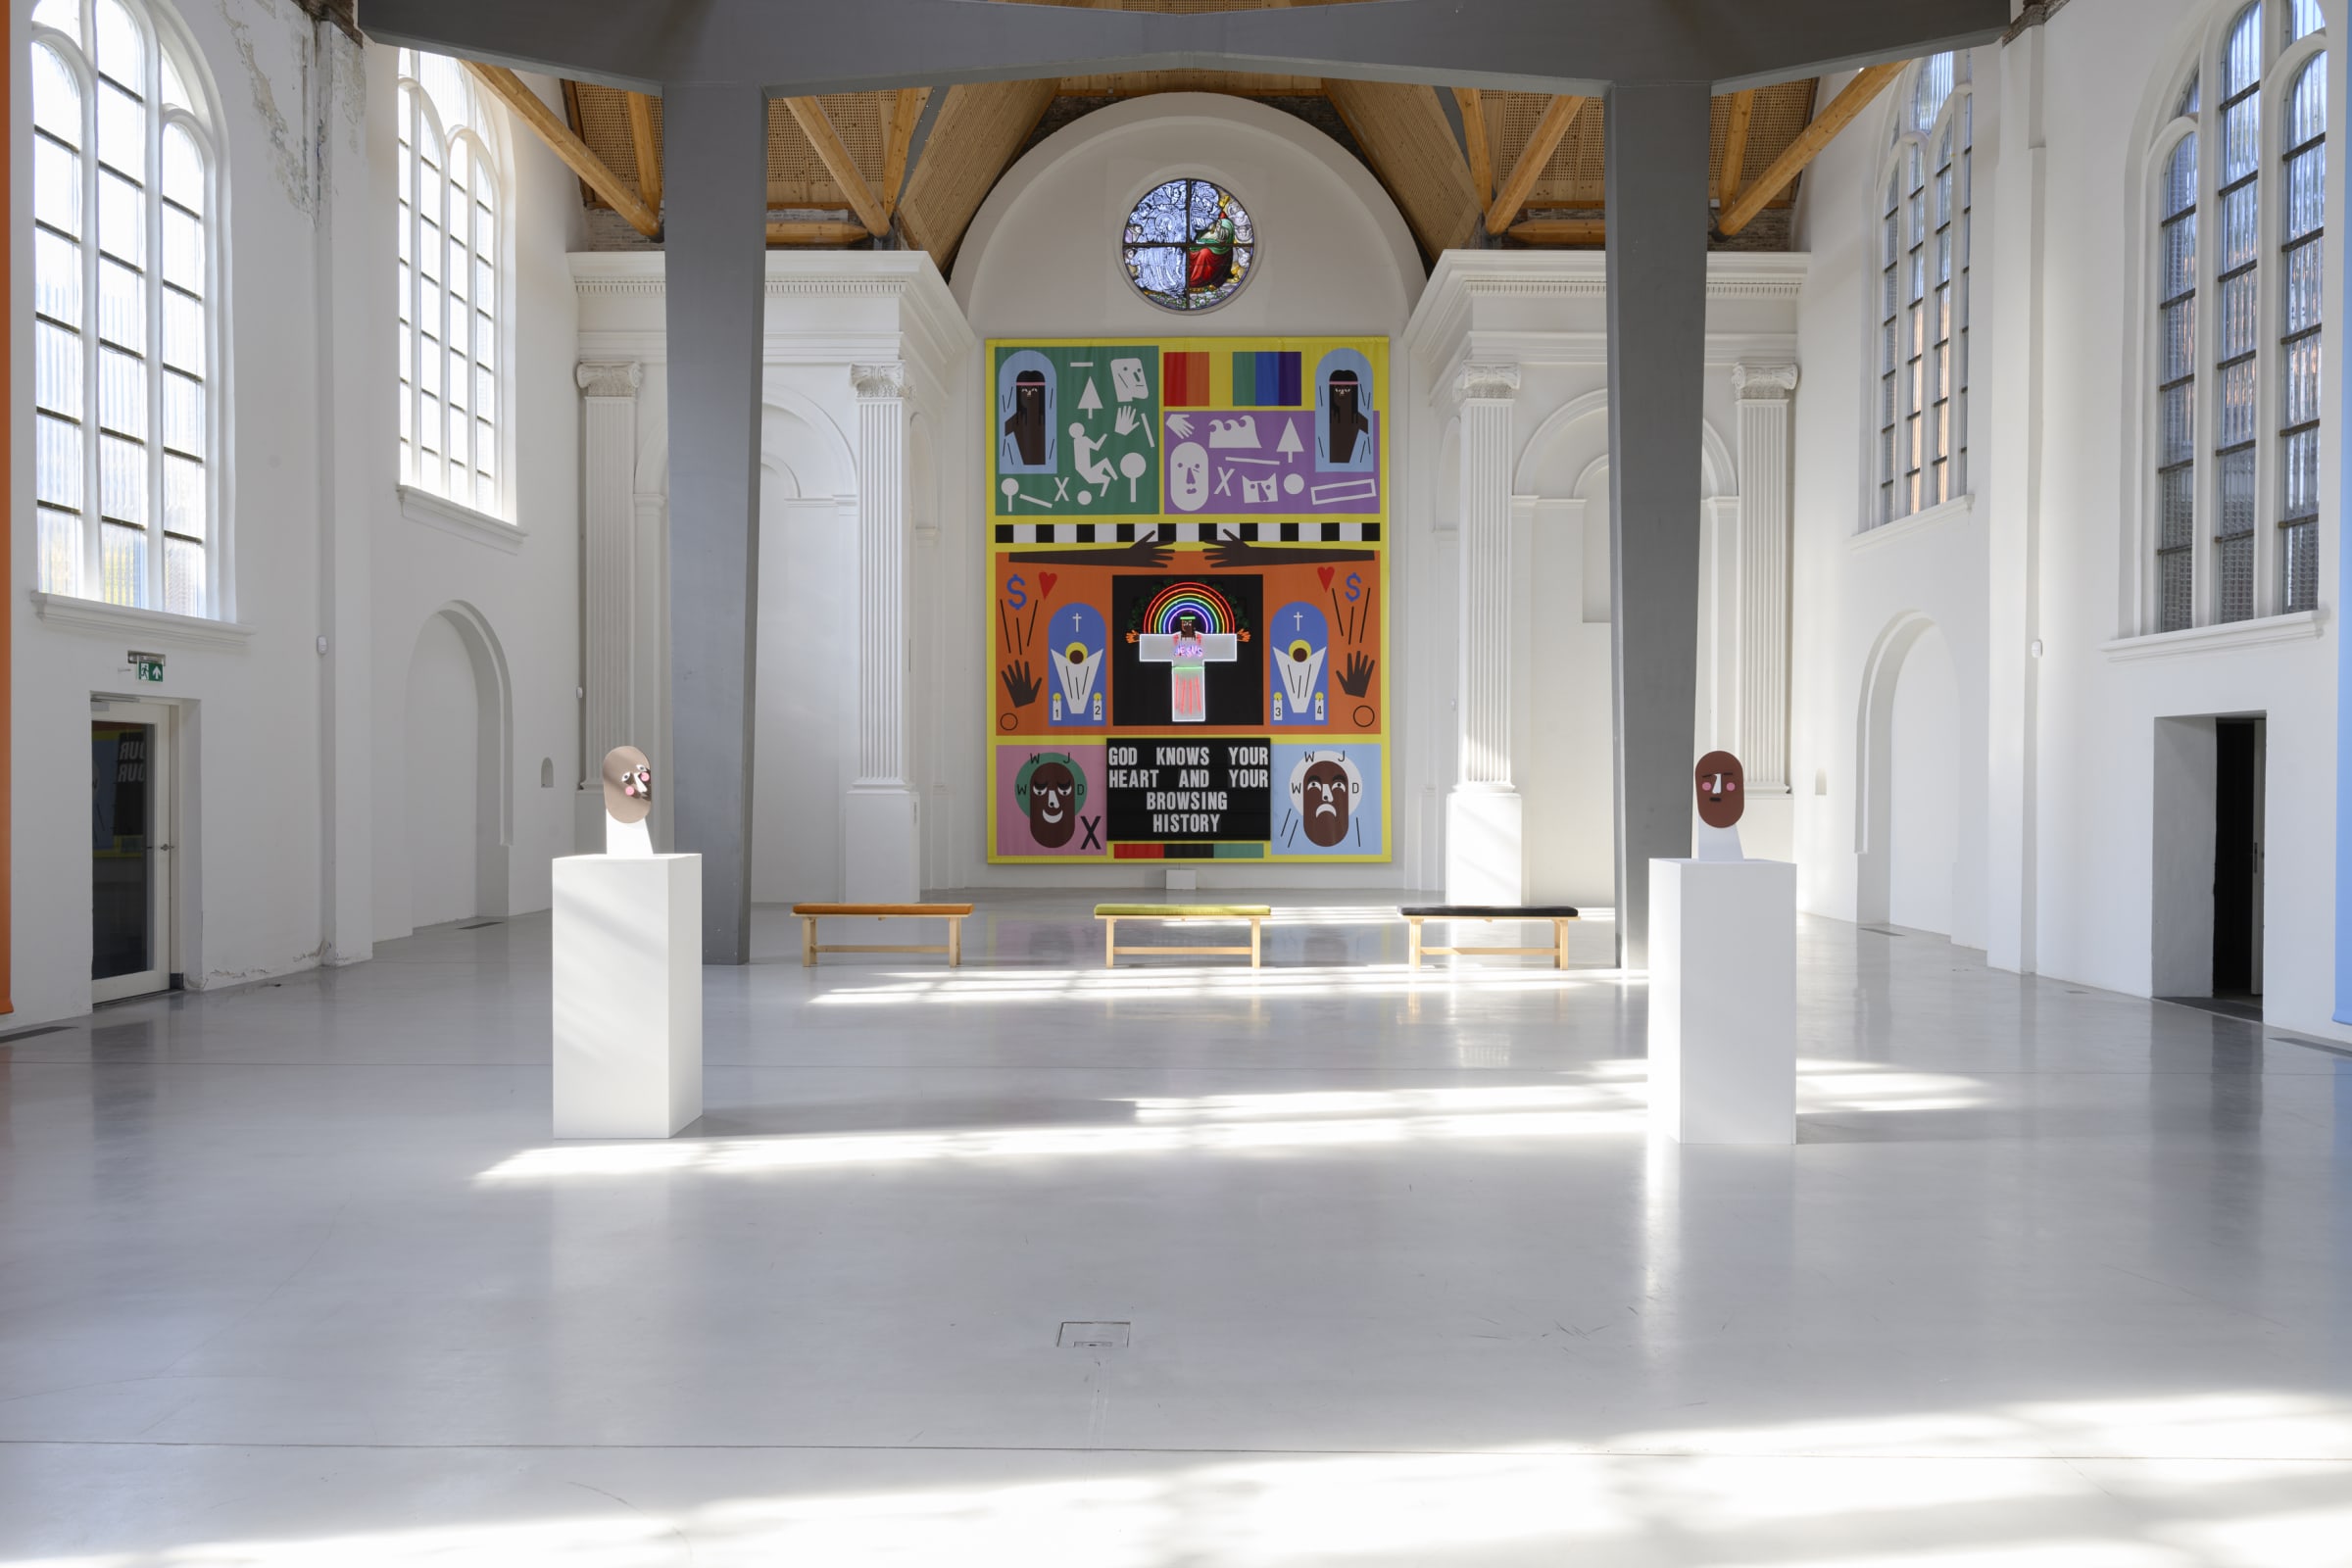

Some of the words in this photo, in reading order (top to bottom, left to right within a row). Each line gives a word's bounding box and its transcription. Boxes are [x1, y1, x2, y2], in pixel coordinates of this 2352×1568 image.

[1175, 645, 1203, 658] JESUS
[1095, 705, 1101, 715] 2
[1275, 707, 1282, 717] 3
[1316, 705, 1322, 715] 4
[1108, 747, 1138, 766] GOD
[1155, 747, 1210, 766] KNOWS
[1228, 747, 1269, 766] YOUR
[1017, 784, 1028, 796] W
[1029, 753, 1040, 763] W
[1063, 753, 1071, 763] J
[1077, 784, 1085, 796] D
[1108, 769, 1159, 788] HEART
[1178, 769, 1209, 788] AND
[1228, 769, 1269, 788] YOUR
[1291, 783, 1301, 794] W
[1304, 751, 1315, 762] W
[1338, 750, 1346, 762] J
[1352, 783, 1359, 794] D
[1146, 792, 1228, 810] BROWSING
[1152, 814, 1221, 833] HISTORY
